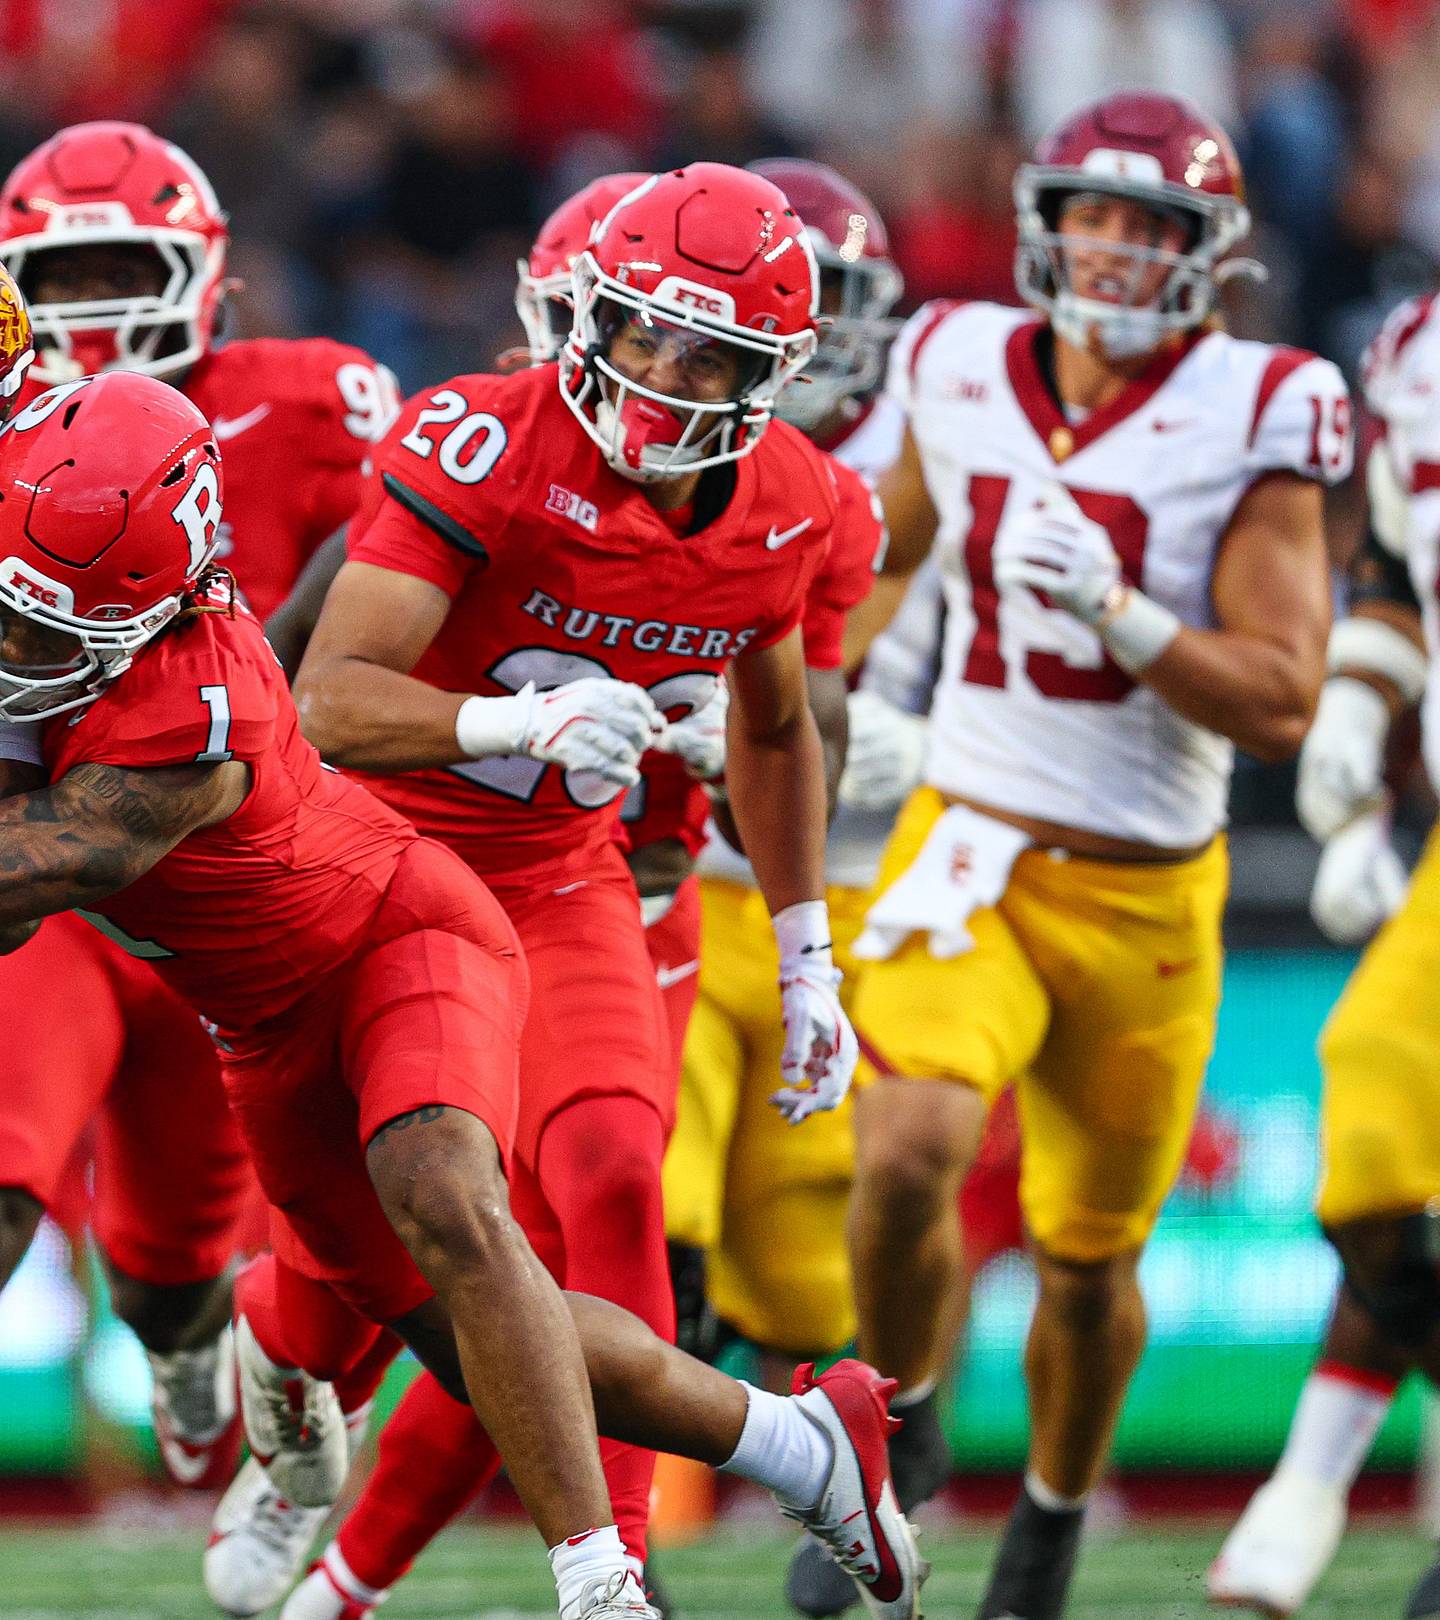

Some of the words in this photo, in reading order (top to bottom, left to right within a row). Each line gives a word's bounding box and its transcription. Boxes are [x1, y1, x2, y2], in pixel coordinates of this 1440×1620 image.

[672, 287, 722, 315] FTG
[401, 389, 508, 486] 20
[170, 462, 223, 577] R
[521, 588, 758, 657] RUTGERS
[194, 684, 234, 762] 1
